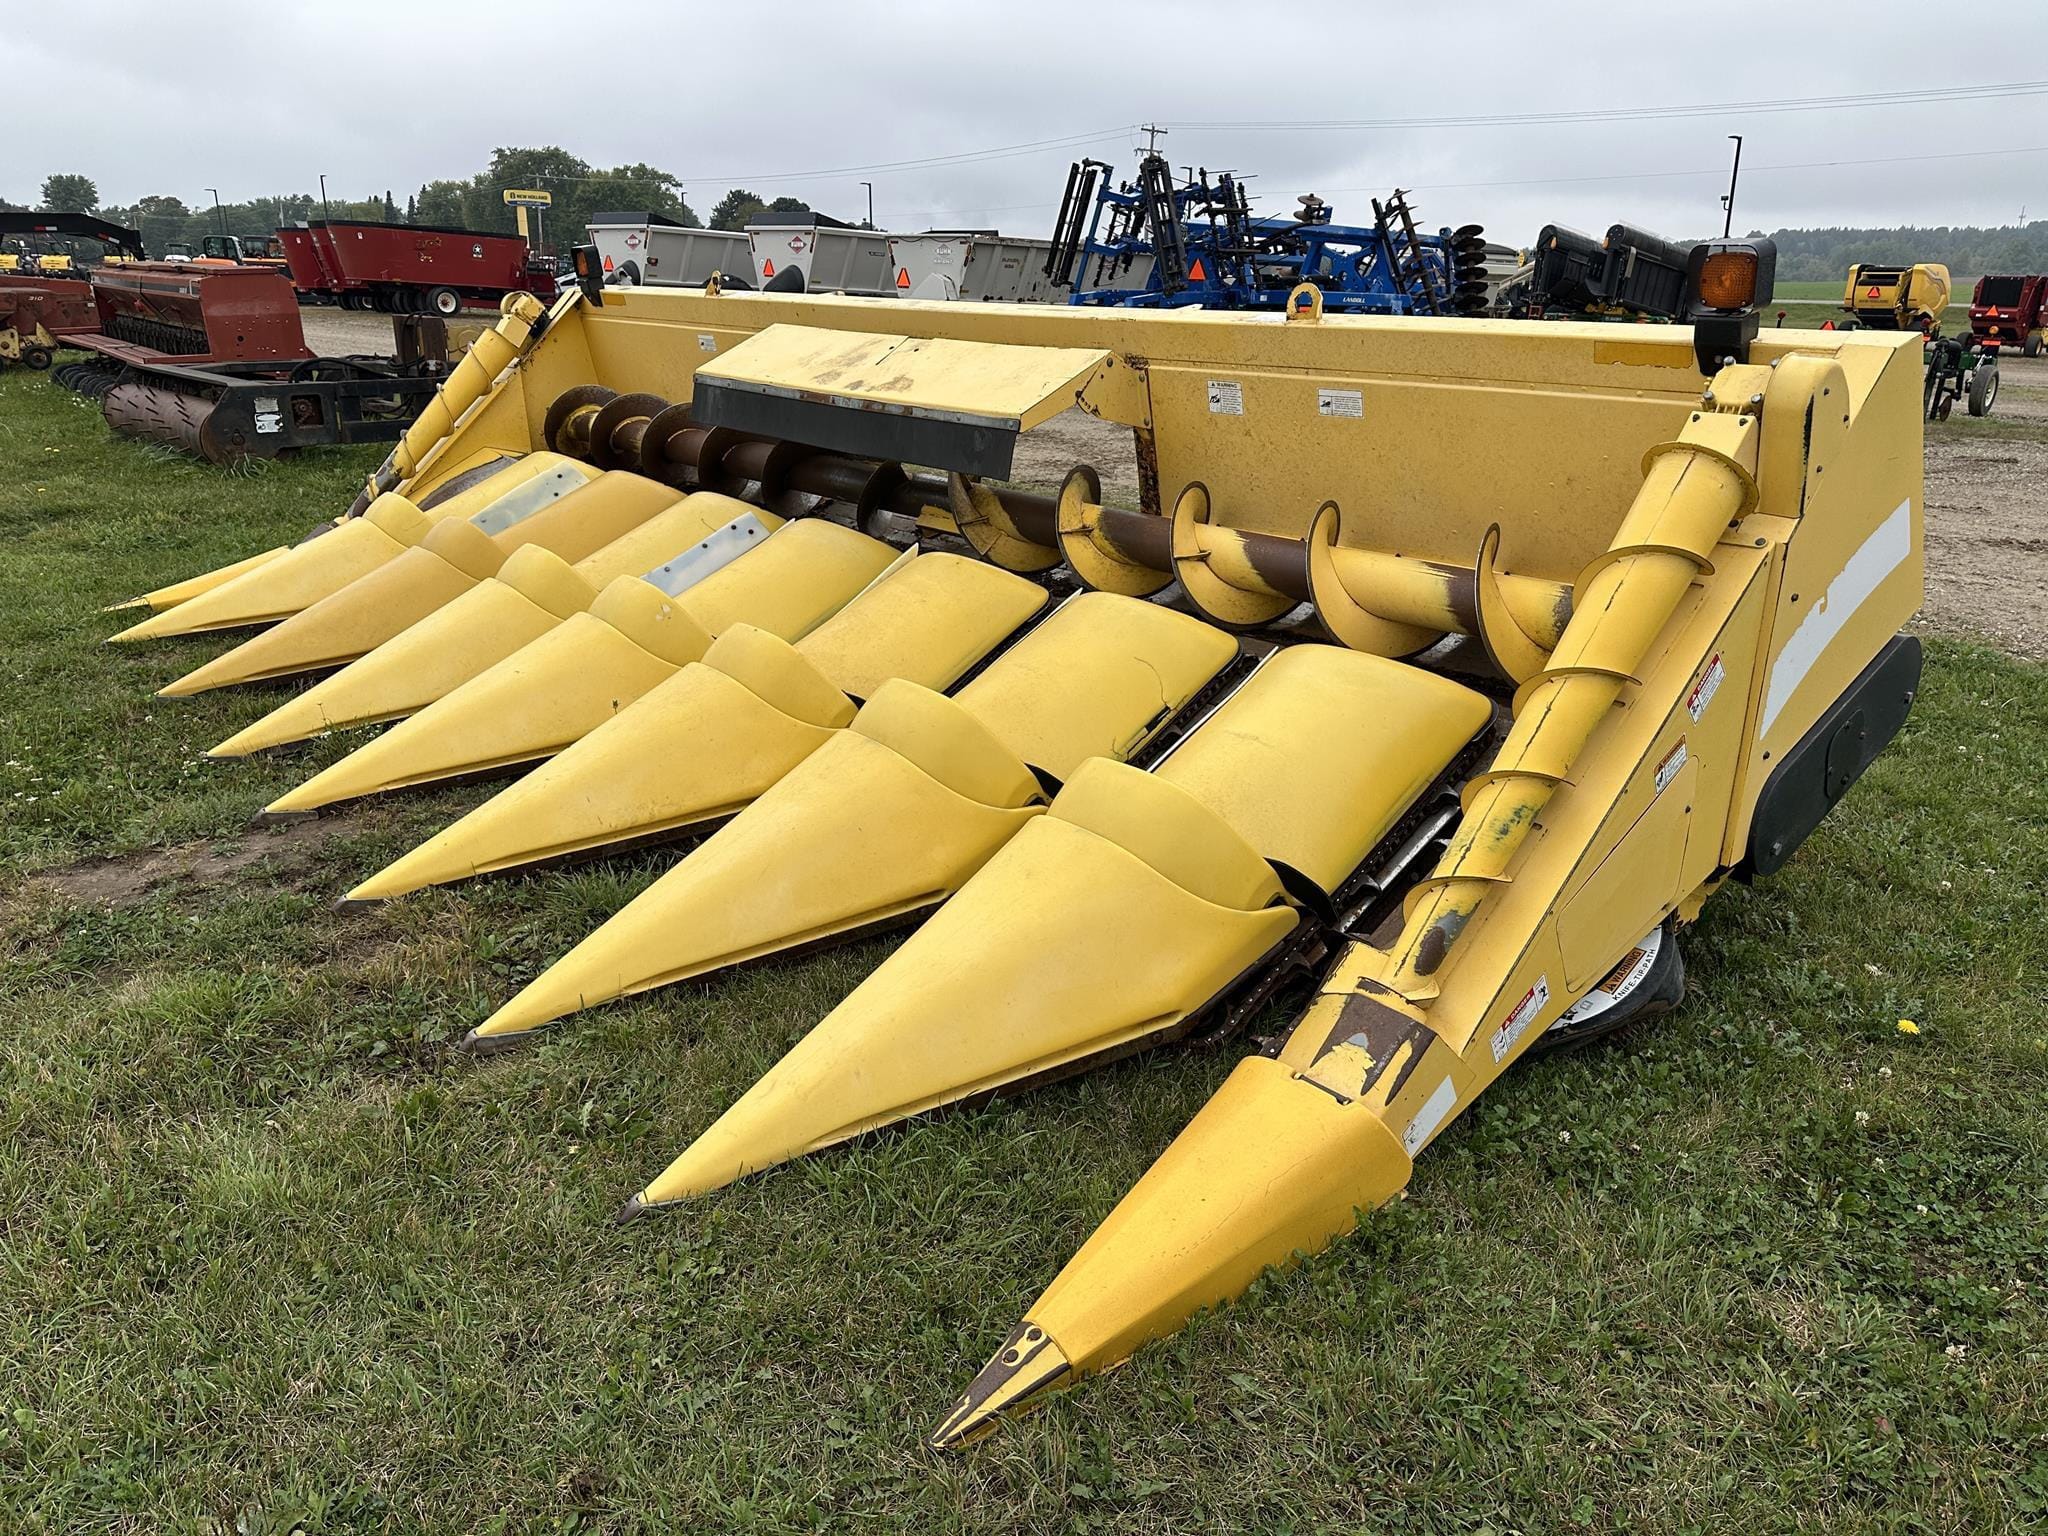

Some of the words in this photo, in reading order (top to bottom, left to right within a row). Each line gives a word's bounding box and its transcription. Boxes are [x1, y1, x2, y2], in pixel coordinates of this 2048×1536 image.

[1342, 296, 1366, 304] LANDOLL
[1697, 662, 1715, 692] DANGER
[1611, 948, 1656, 1001] KNIFE-TIP-PATH
[1615, 949, 1643, 983] WARNING
[1509, 993, 1532, 1020] DANGER
